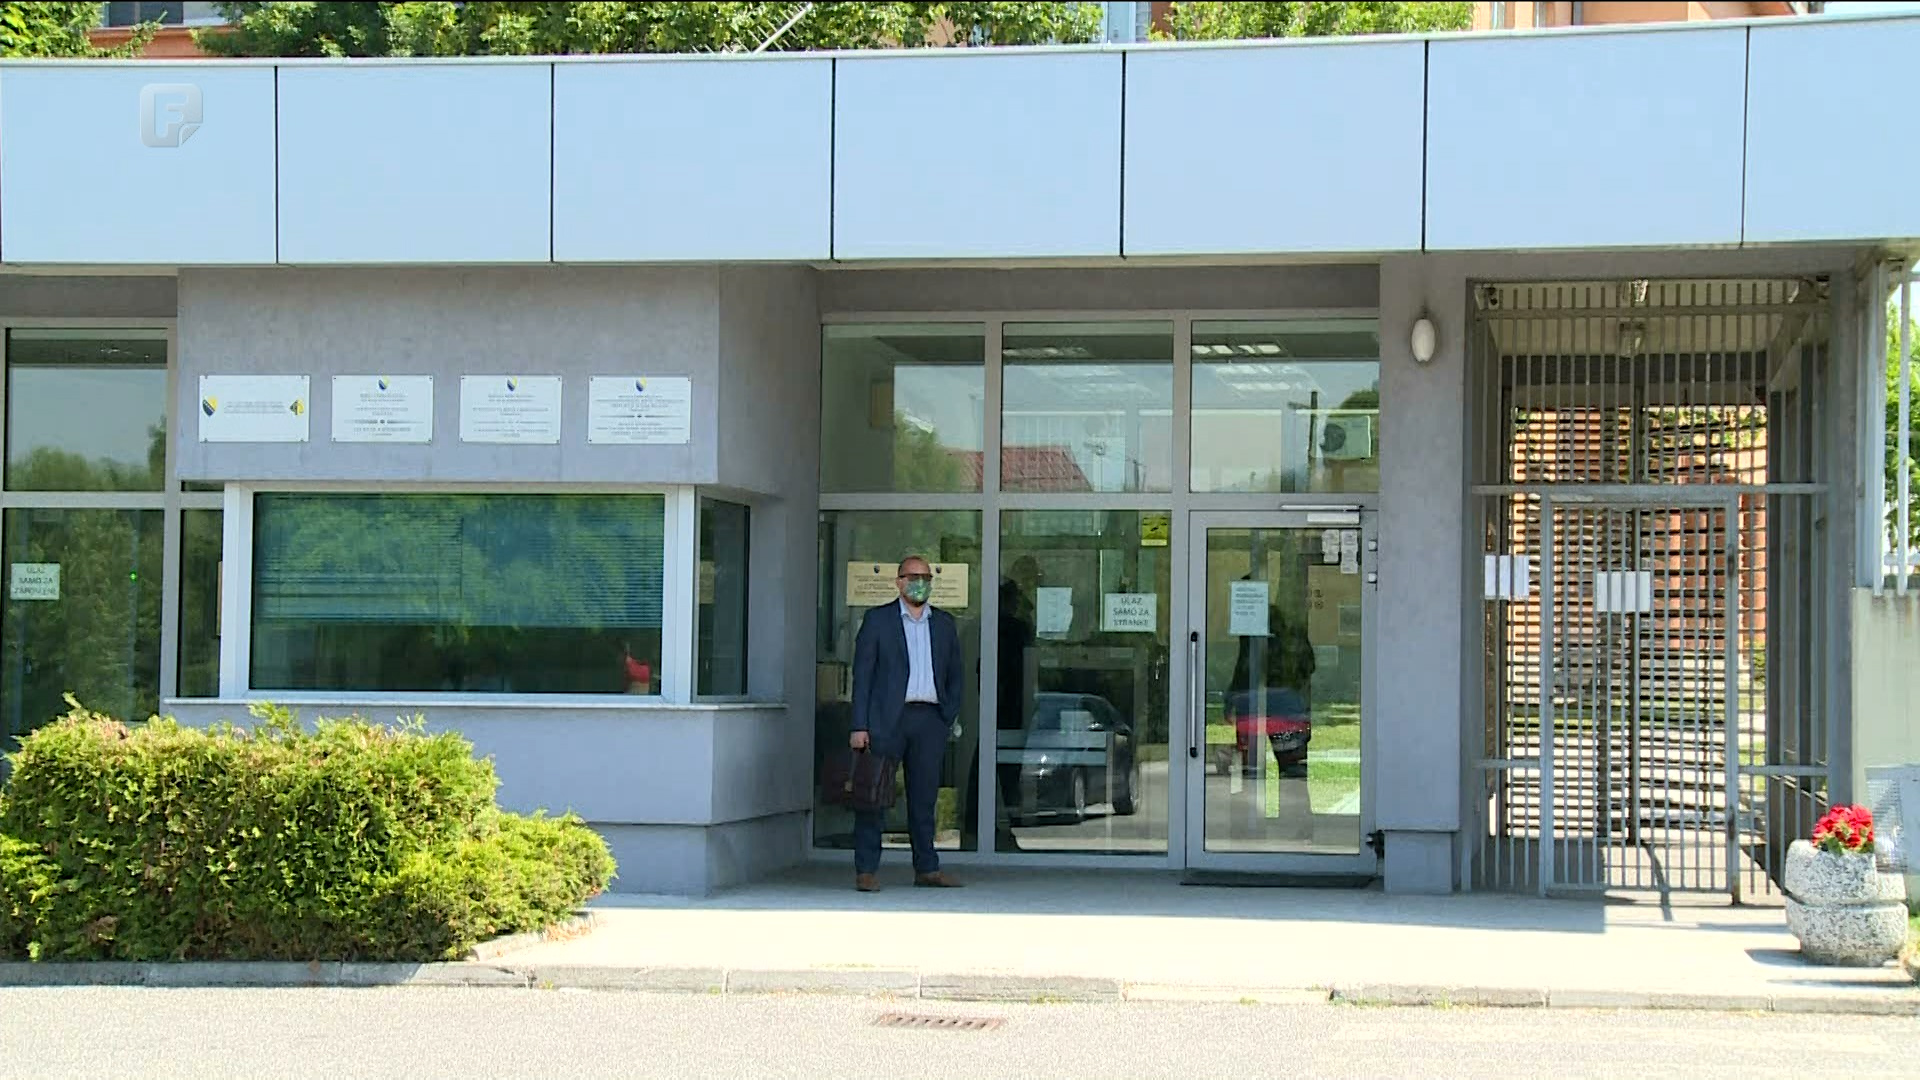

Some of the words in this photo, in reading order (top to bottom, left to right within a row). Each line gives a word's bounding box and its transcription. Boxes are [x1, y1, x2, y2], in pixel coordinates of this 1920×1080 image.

[1121, 597, 1143, 605] ULAZ
[1113, 607, 1137, 616] SAMO
[1138, 607, 1150, 616] ZA
